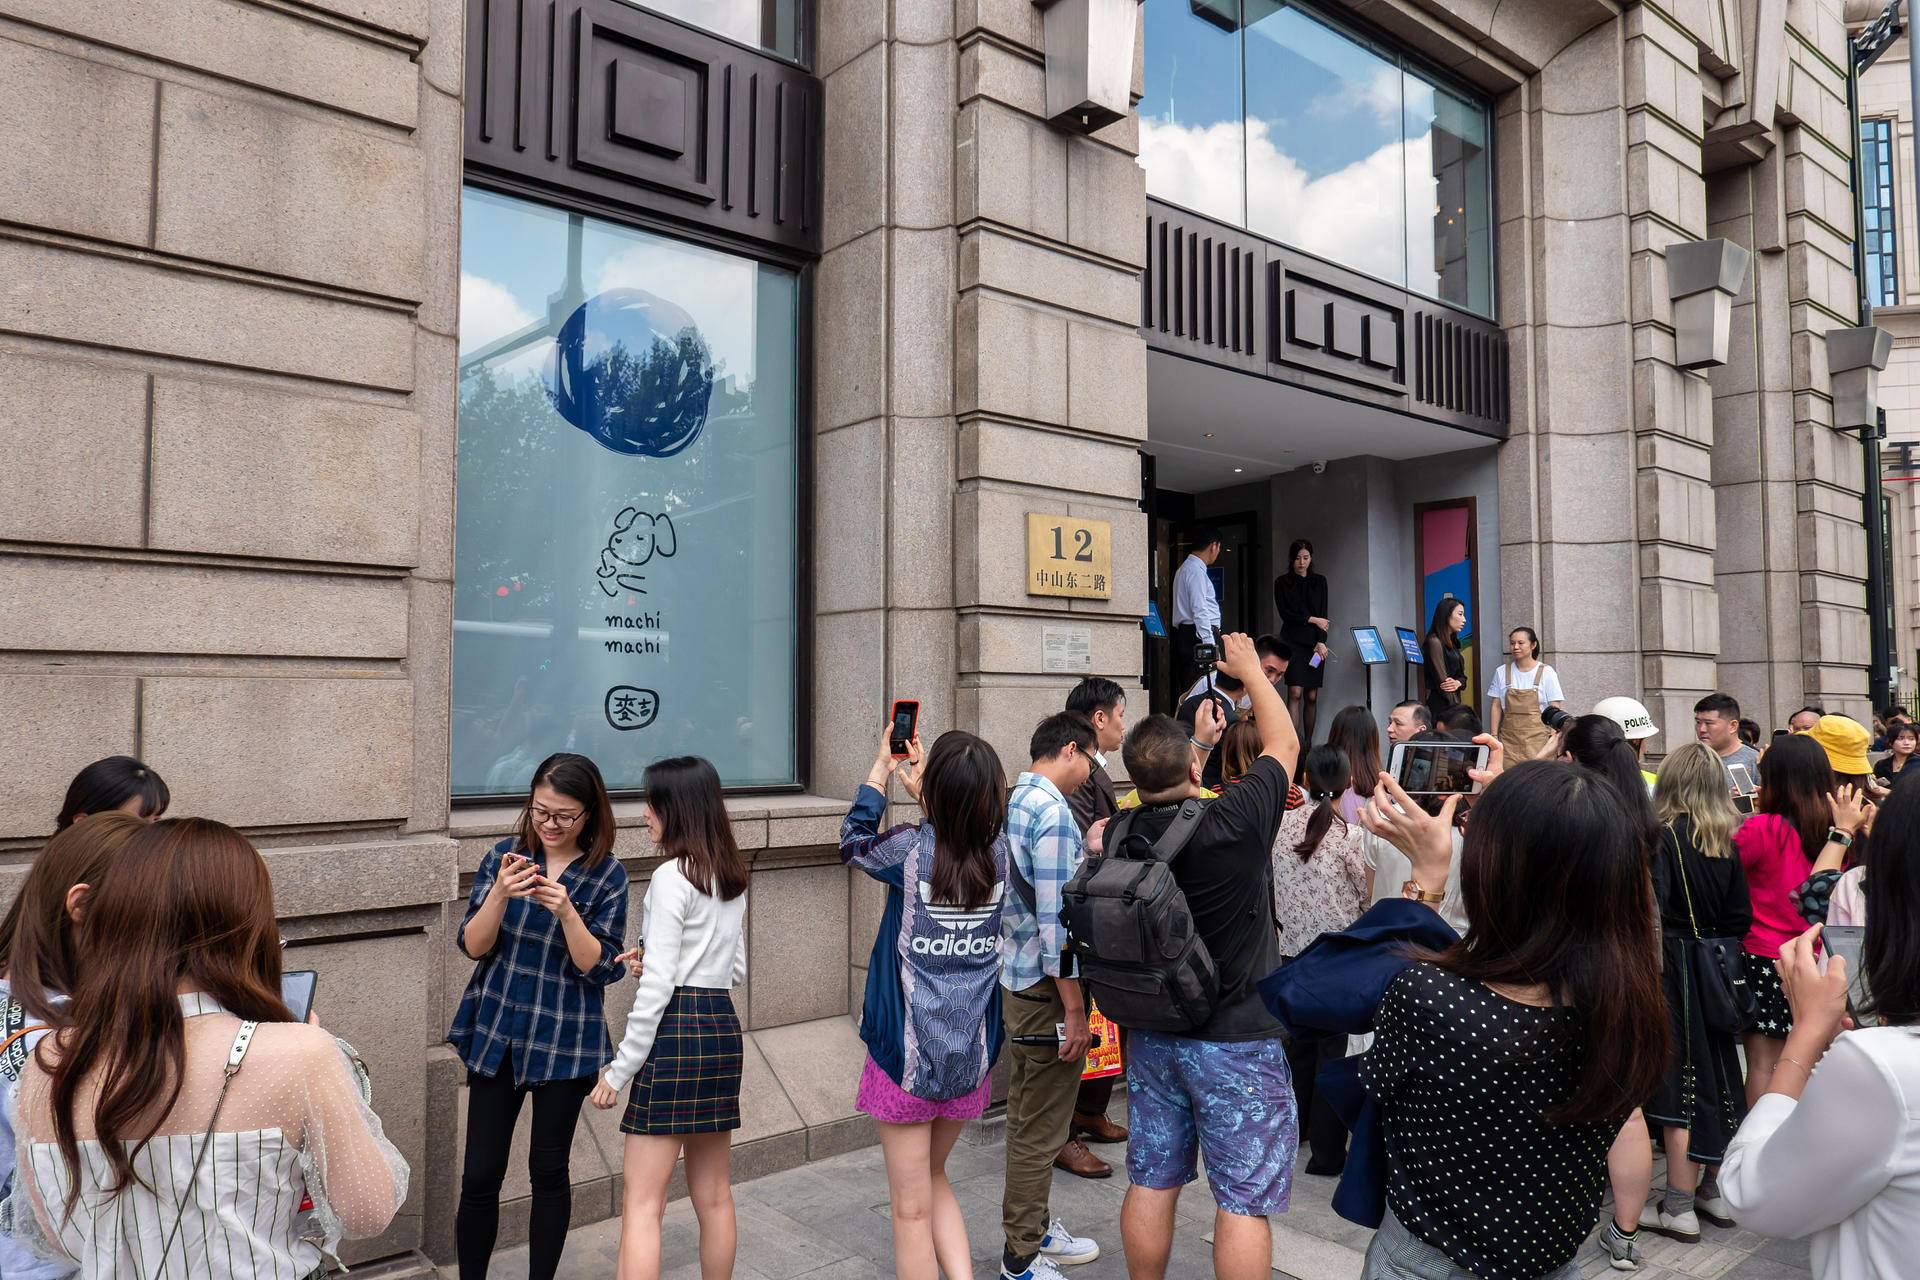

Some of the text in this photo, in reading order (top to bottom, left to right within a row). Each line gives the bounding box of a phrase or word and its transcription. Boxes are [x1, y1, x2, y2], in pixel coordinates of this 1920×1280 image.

[1050, 526, 1093, 562] 12
[1036, 568, 1106, 592] 中山东二路
[605, 611, 660, 629] machi
[605, 636, 660, 653] machi
[911, 933, 996, 956] adidas
